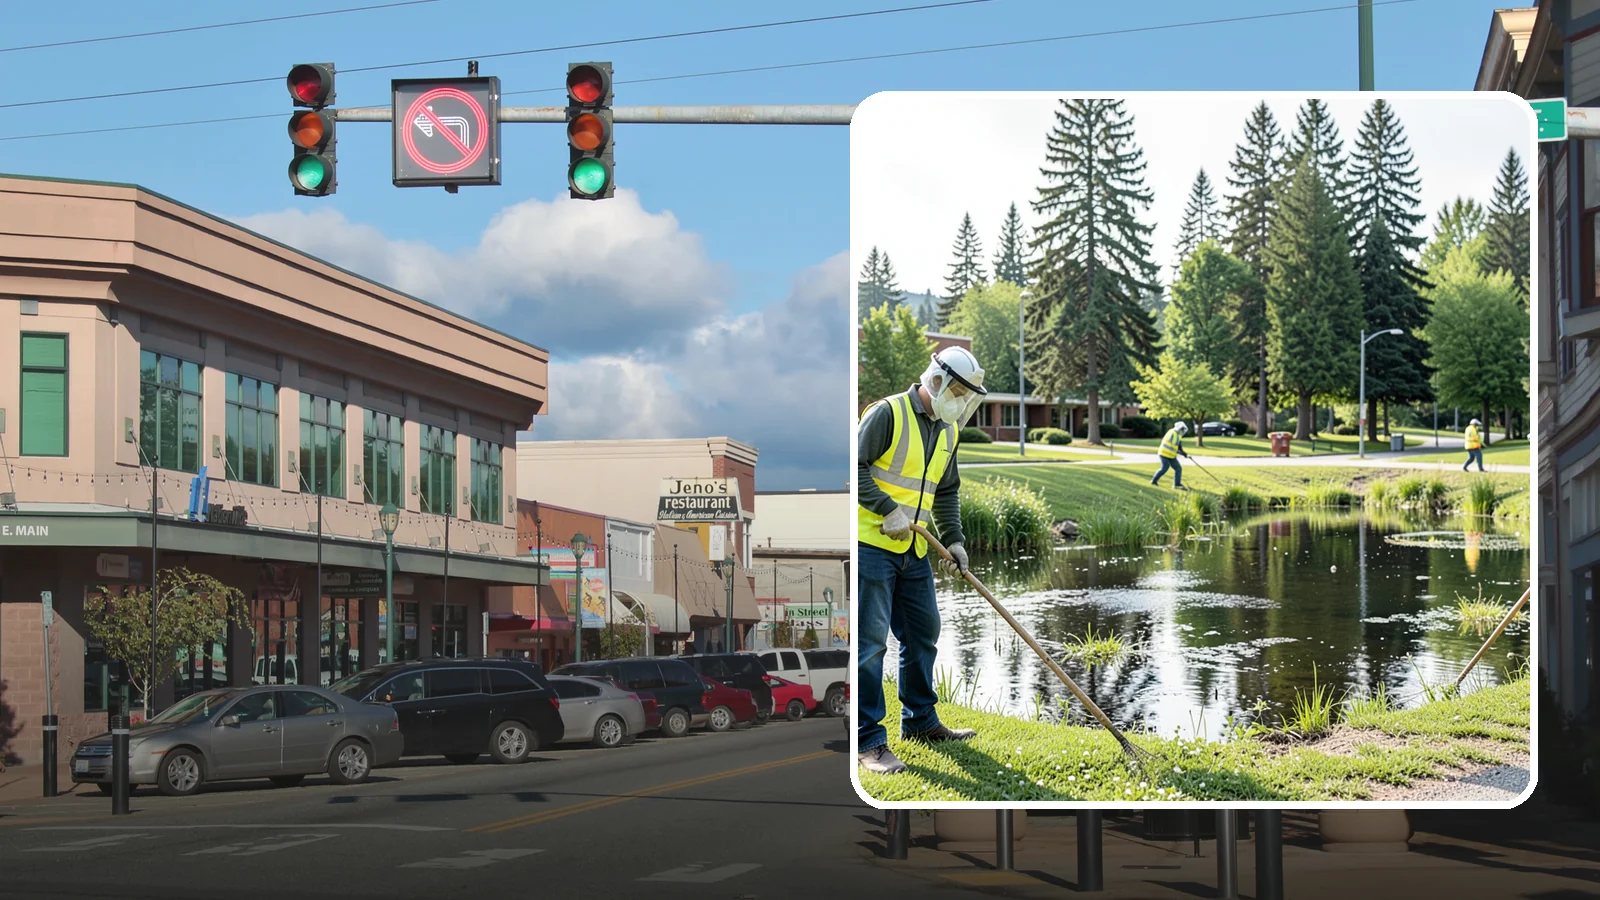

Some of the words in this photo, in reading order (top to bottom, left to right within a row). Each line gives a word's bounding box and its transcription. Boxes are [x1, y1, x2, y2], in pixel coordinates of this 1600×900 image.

[670, 480, 728, 494] Jeno's
[665, 496, 731, 509] restaurant
[658, 510, 682, 520] Italian
[686, 510, 714, 520] American
[715, 510, 738, 519] Cuisine
[2, 525, 13, 536] E.
[16, 525, 49, 536] MAIN
[786, 608, 794, 616] in
[797, 608, 828, 616] Street
